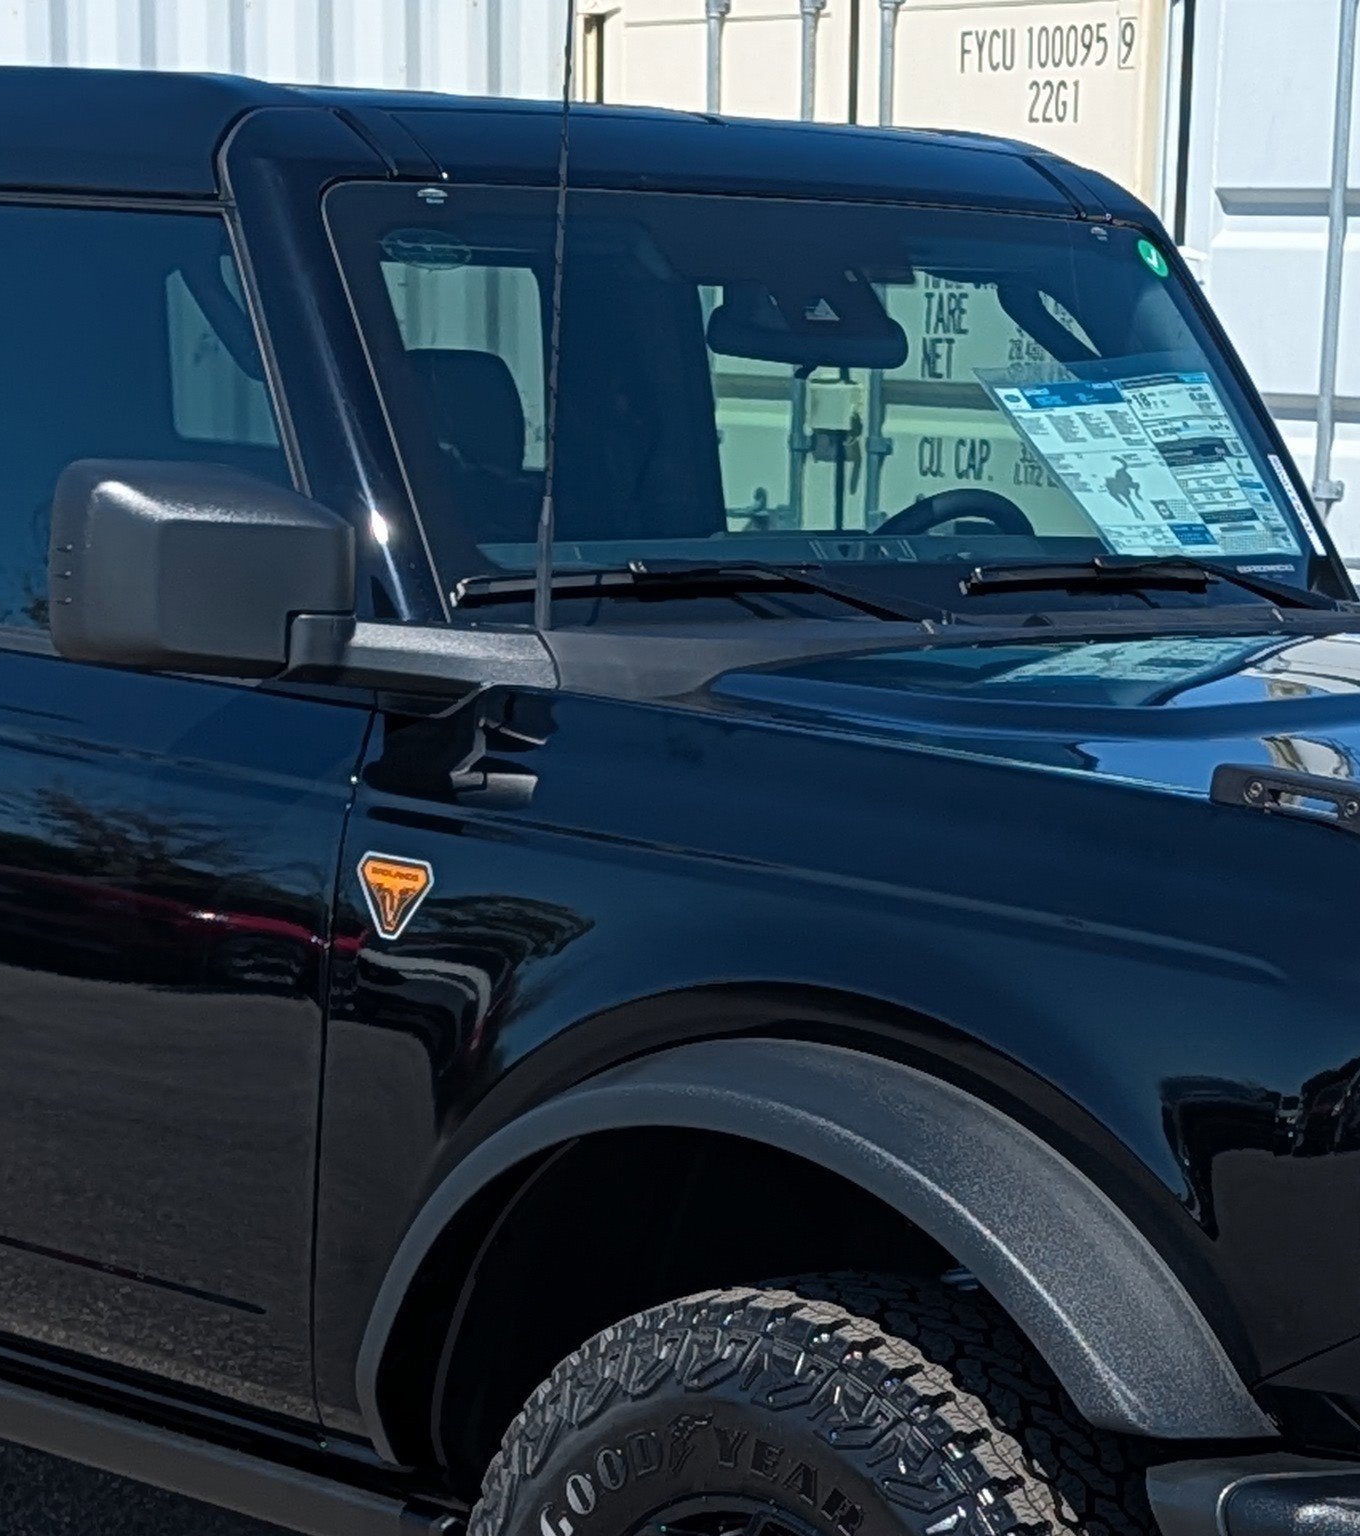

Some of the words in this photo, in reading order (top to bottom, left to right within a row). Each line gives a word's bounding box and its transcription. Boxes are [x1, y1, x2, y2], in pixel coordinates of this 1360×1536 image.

[960, 28, 1016, 74] FYCU
[1027, 22, 1108, 70] 100095
[1120, 20, 1136, 67] 9
[1027, 79, 1080, 124] 22G1
[924, 292, 969, 334] TARE
[921, 337, 955, 379] NET
[955, 437, 994, 482] CAP.
